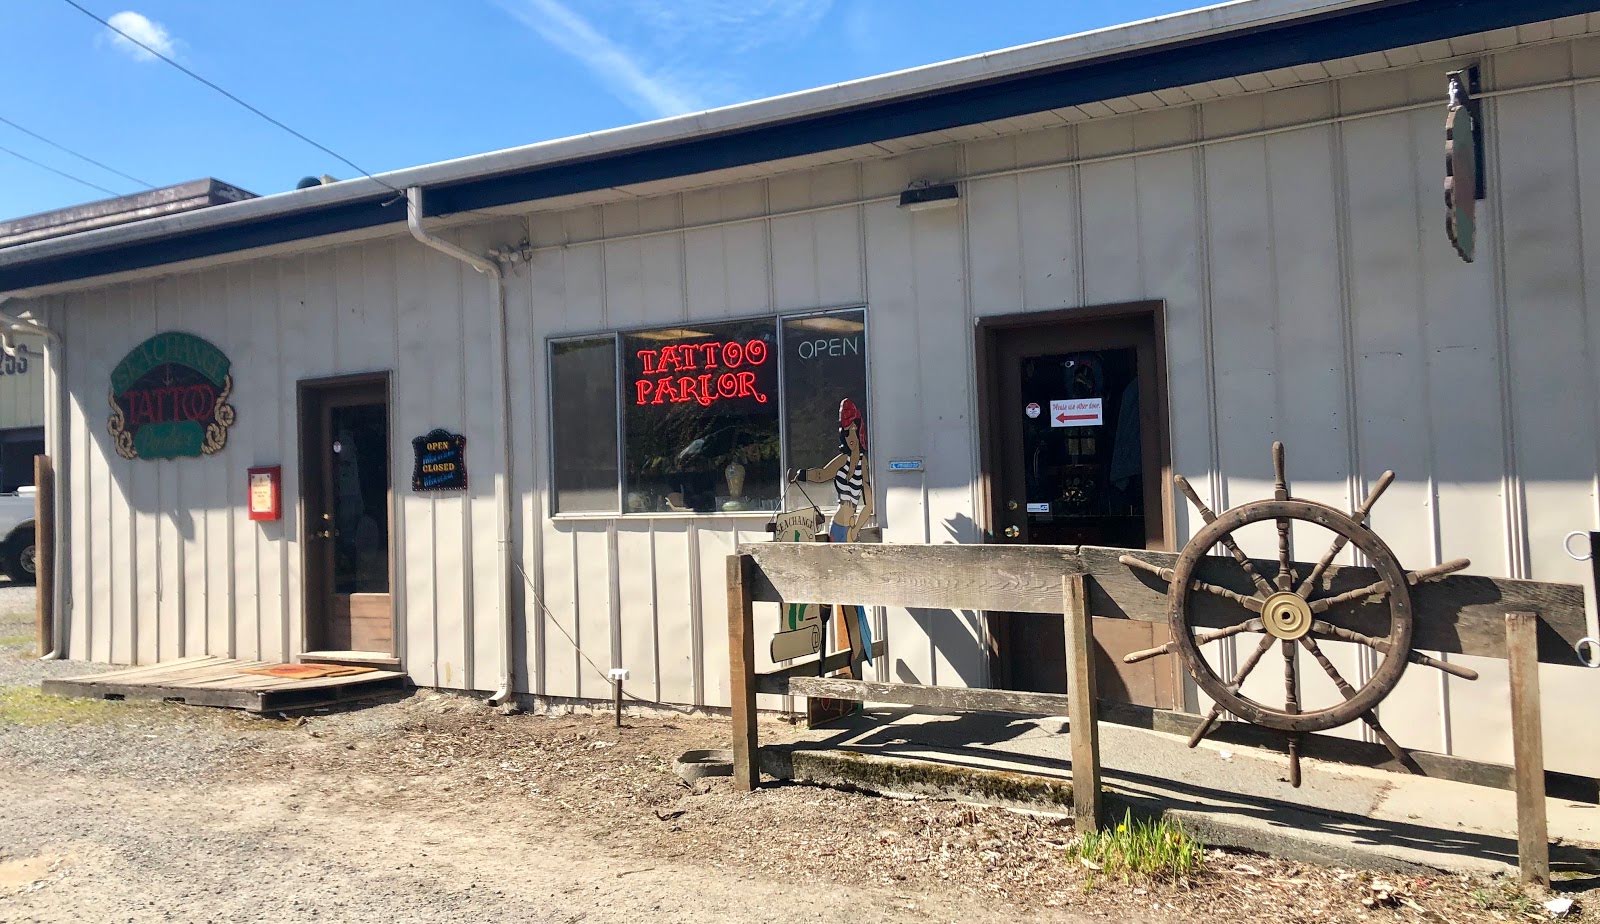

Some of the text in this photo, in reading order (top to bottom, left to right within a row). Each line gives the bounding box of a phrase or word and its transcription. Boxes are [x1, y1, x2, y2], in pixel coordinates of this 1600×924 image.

[637, 339, 767, 374] TATTOO
[798, 336, 859, 359] OPEN
[635, 371, 767, 407] PARLOR
[121, 384, 216, 425] TATTOO
[426, 441, 449, 451] OPEN
[422, 462, 455, 473] CLOSED
